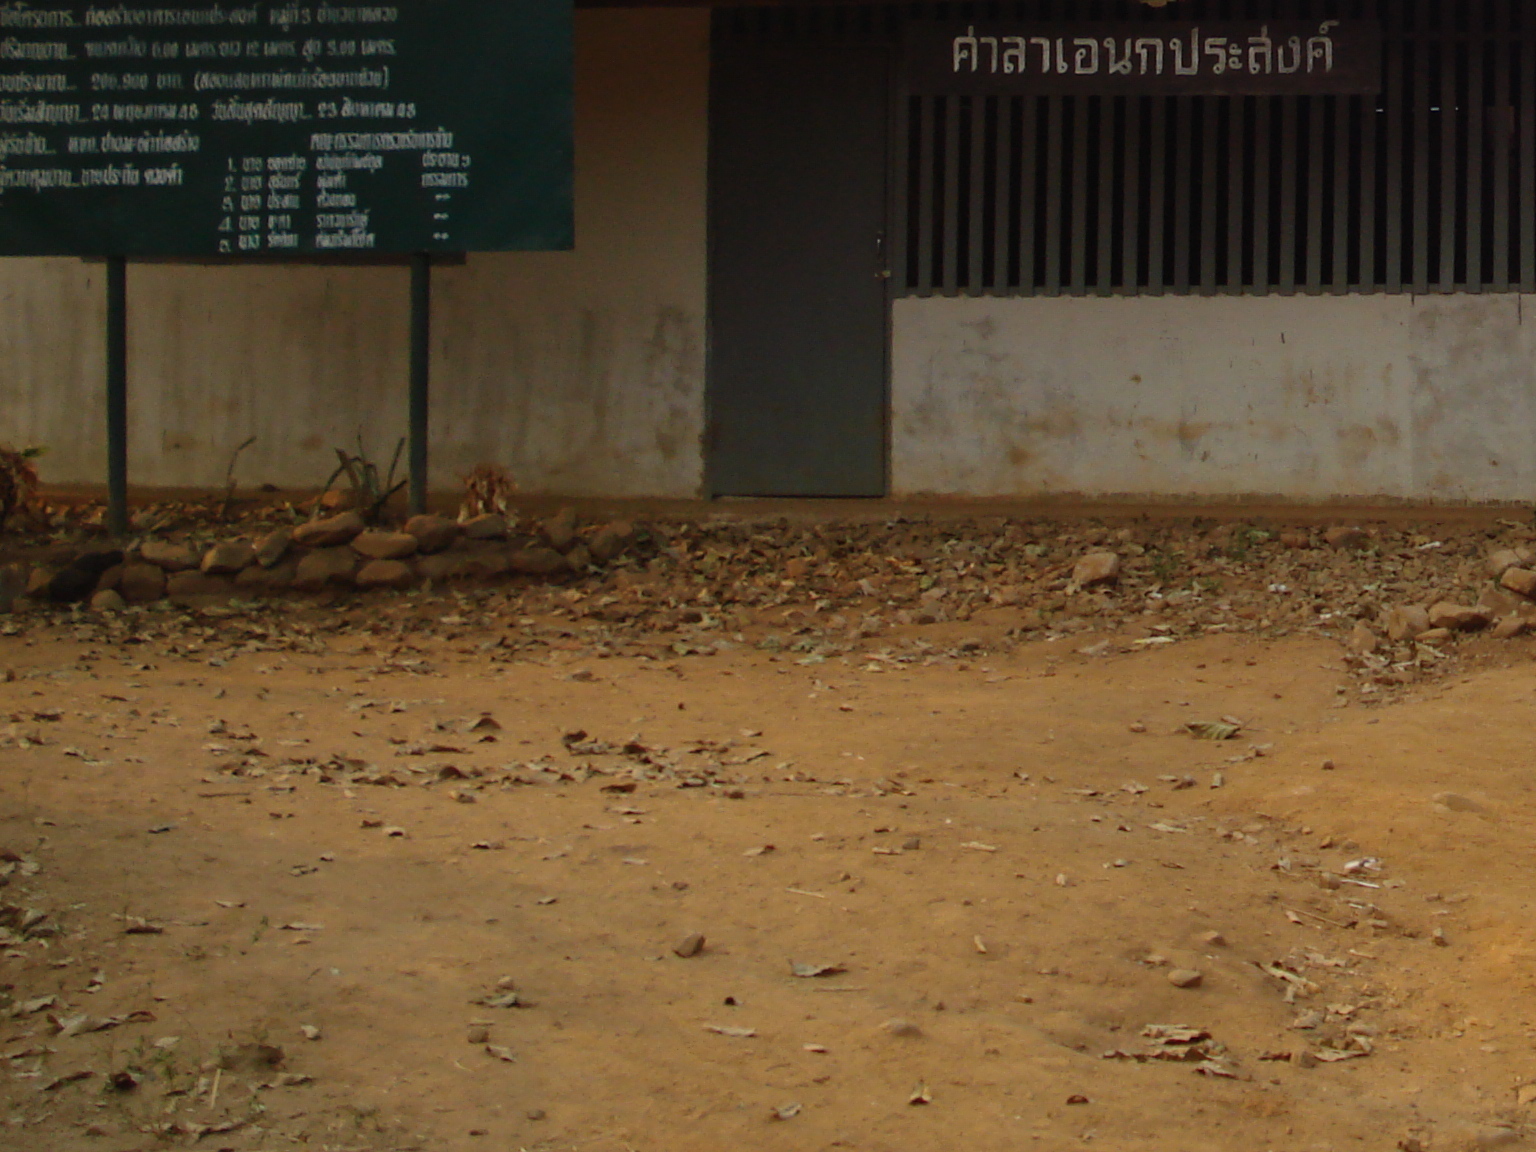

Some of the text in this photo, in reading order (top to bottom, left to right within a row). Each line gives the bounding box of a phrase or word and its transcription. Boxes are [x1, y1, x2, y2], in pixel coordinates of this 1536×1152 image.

[952, 19, 1341, 76] ศาลาเอนกประสงค์
